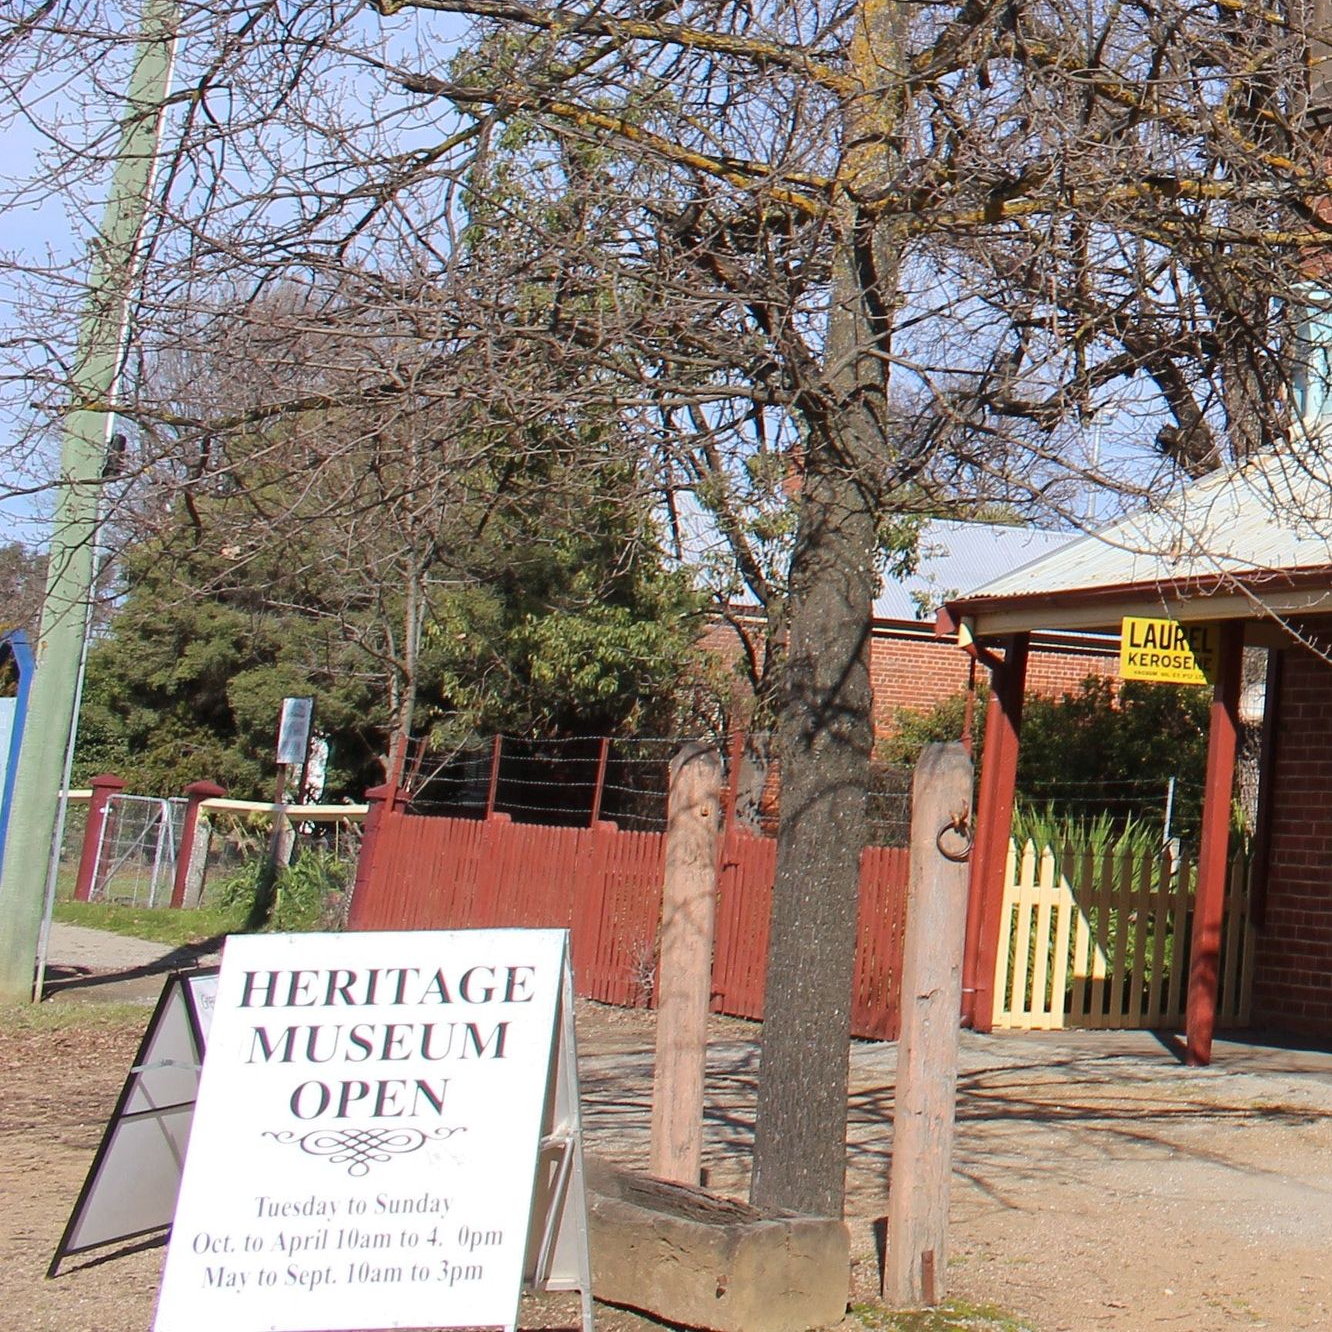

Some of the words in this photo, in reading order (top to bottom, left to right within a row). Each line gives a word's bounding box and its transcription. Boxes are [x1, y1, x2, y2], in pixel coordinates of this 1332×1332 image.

[1130, 622, 1213, 654] LAUREL
[1128, 652, 1211, 672] KEROSENE
[238, 965, 536, 1009] HERITAGE
[245, 1020, 512, 1065] MUSEUM
[289, 1077, 452, 1121] OPEN
[254, 1195, 340, 1221] Tuesday
[348, 1199, 366, 1215] to
[374, 1192, 454, 1219] Sunday
[192, 1231, 236, 1254] Oct.
[244, 1234, 264, 1253] to
[270, 1228, 328, 1257] April
[336, 1226, 393, 1250] 10am
[400, 1229, 420, 1248] to
[201, 1266, 250, 1294] May
[257, 1268, 278, 1287] to
[284, 1264, 336, 1291] Sept.
[347, 1261, 402, 1285] 10am
[410, 1264, 431, 1282] to
[436, 1260, 485, 1287] 3pm
